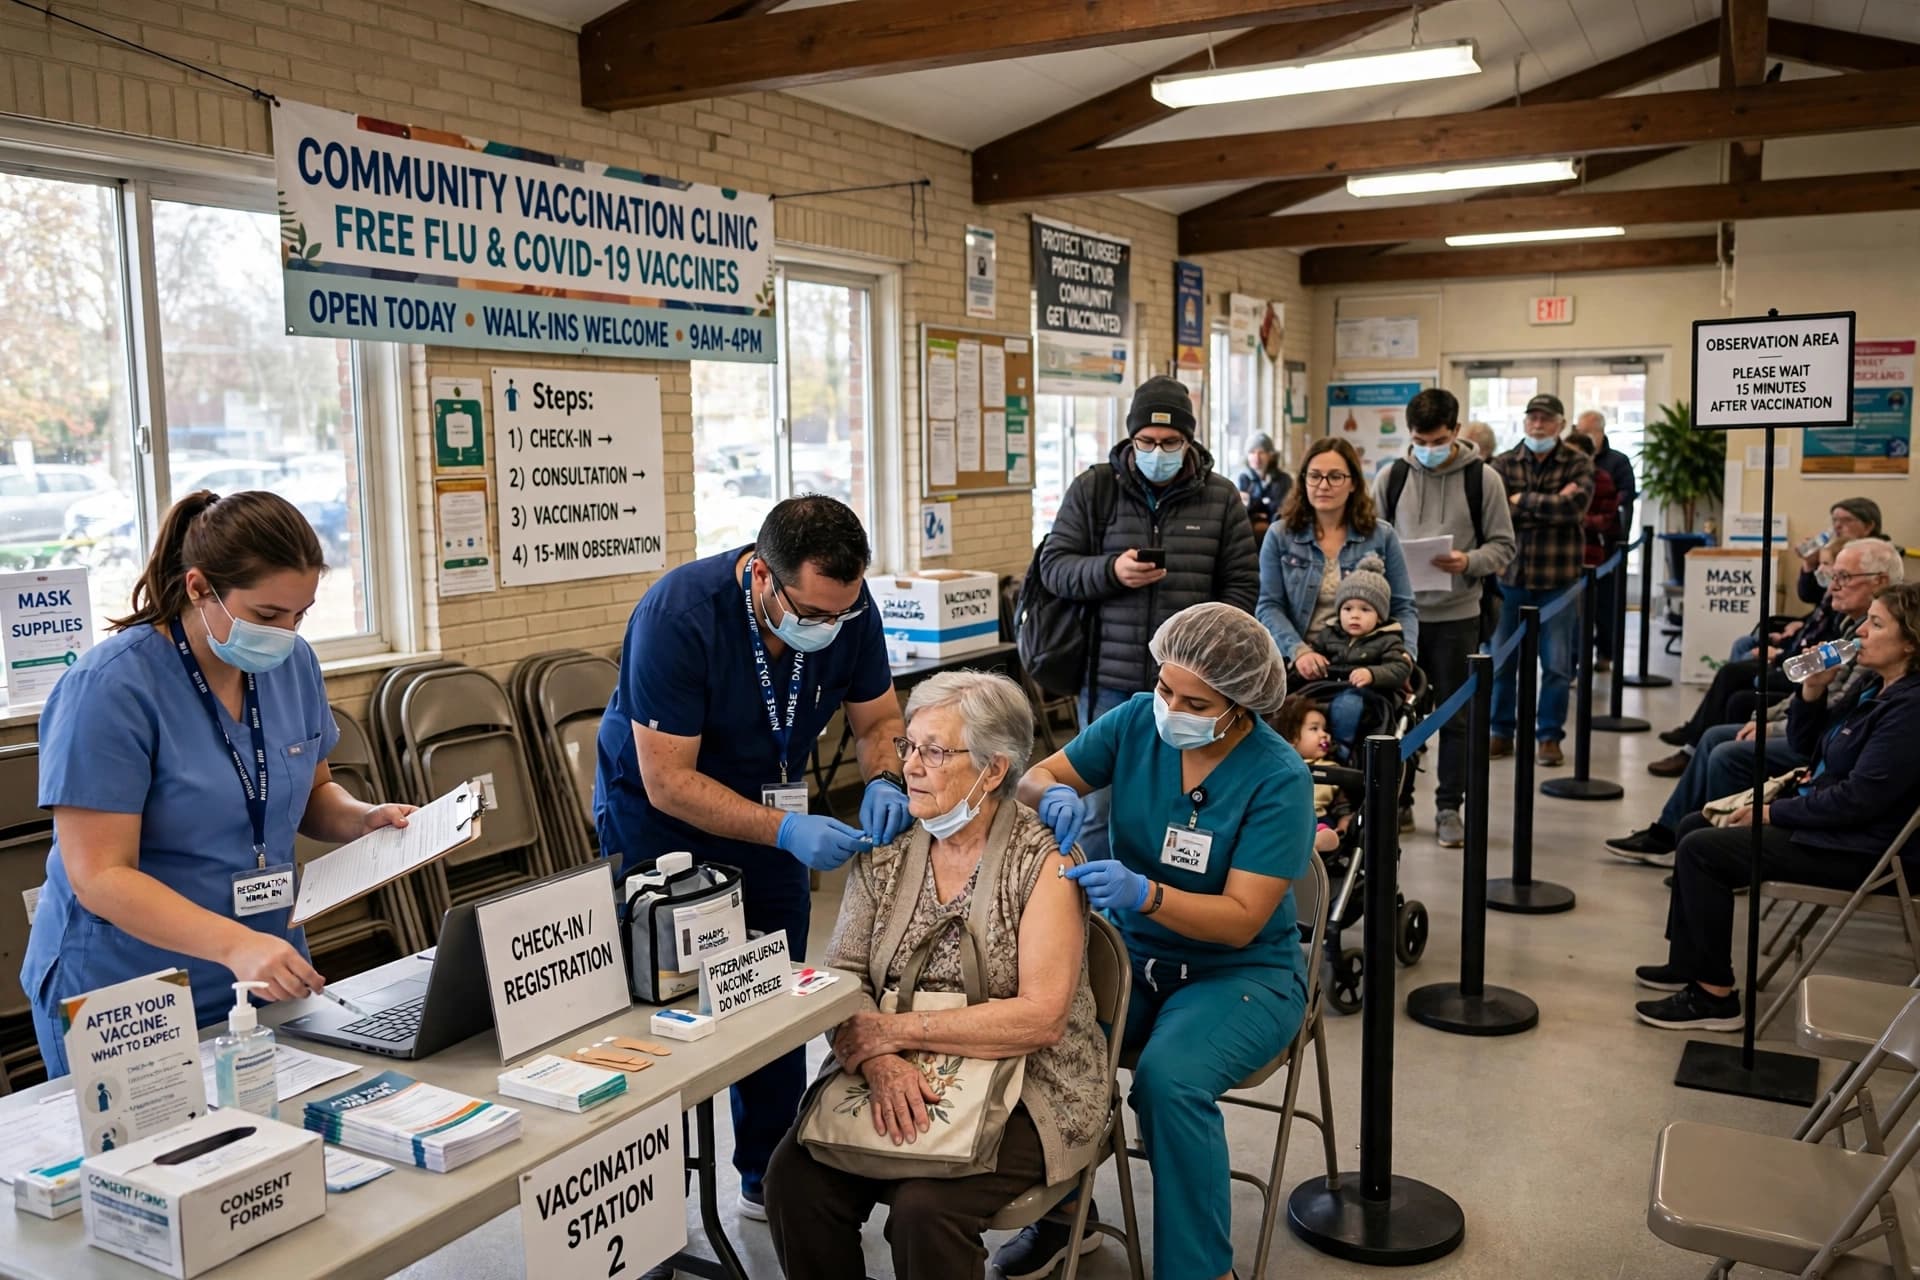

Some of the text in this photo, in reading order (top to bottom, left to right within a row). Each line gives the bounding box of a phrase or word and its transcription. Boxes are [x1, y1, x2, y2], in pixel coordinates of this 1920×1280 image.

[298, 136, 759, 252] COMMUNITY VACCINATION CLINIC
[334, 204, 740, 294] FREE FLU & COVID-19 VACCINES
[1041, 228, 1122, 264] PROTECT YOURSELF
[1051, 256, 1114, 287] PROTECT YOUR
[1059, 282, 1113, 310] COMMUNITY
[1537, 298, 1567, 321] EXIT
[309, 289, 763, 354] OPEN TODAY WALK-INS WELCOME 9AM-4PM
[1046, 304, 1121, 334] GET VACCINATED
[1706, 332, 1839, 351] OBSERVATION AREA
[1732, 364, 1811, 380] PLEASE WAIT
[533, 382, 593, 416] Steps:
[1736, 381, 1807, 395] 15 MINUTES
[1710, 396, 1833, 412] AFTER VACCINATION
[508, 427, 592, 453] 1) CHECK-IN
[509, 466, 627, 491] 2) CONSULTATION
[511, 503, 618, 530] 3) VACCINATION
[512, 536, 661, 568] 4) 15-MIN OBSERVATION
[1706, 569, 1753, 584] MASK
[18, 589, 72, 609] MASK
[1709, 599, 1749, 613] FREE
[12, 618, 83, 638] SUPPLIES
[511, 909, 593, 961] CHECK-IN /
[503, 941, 614, 1005] REGISTRATION
[709, 939, 786, 980] PFIZER/INFLUENZA
[716, 969, 754, 995] VACCINE
[719, 975, 782, 1012] DO NOT FREEZE
[86, 993, 176, 1030] AFTER YOUR
[100, 1014, 168, 1044] VACCINE:
[91, 1027, 181, 1063] WHAT TO EXPECT
[88, 1174, 132, 1199] CONSENT
[535, 1124, 670, 1221] VACCINATION
[220, 1172, 292, 1215] CONSENT
[229, 1194, 284, 1231] FORMS
[567, 1174, 654, 1249] STATION
[606, 1235, 626, 1278] 2
